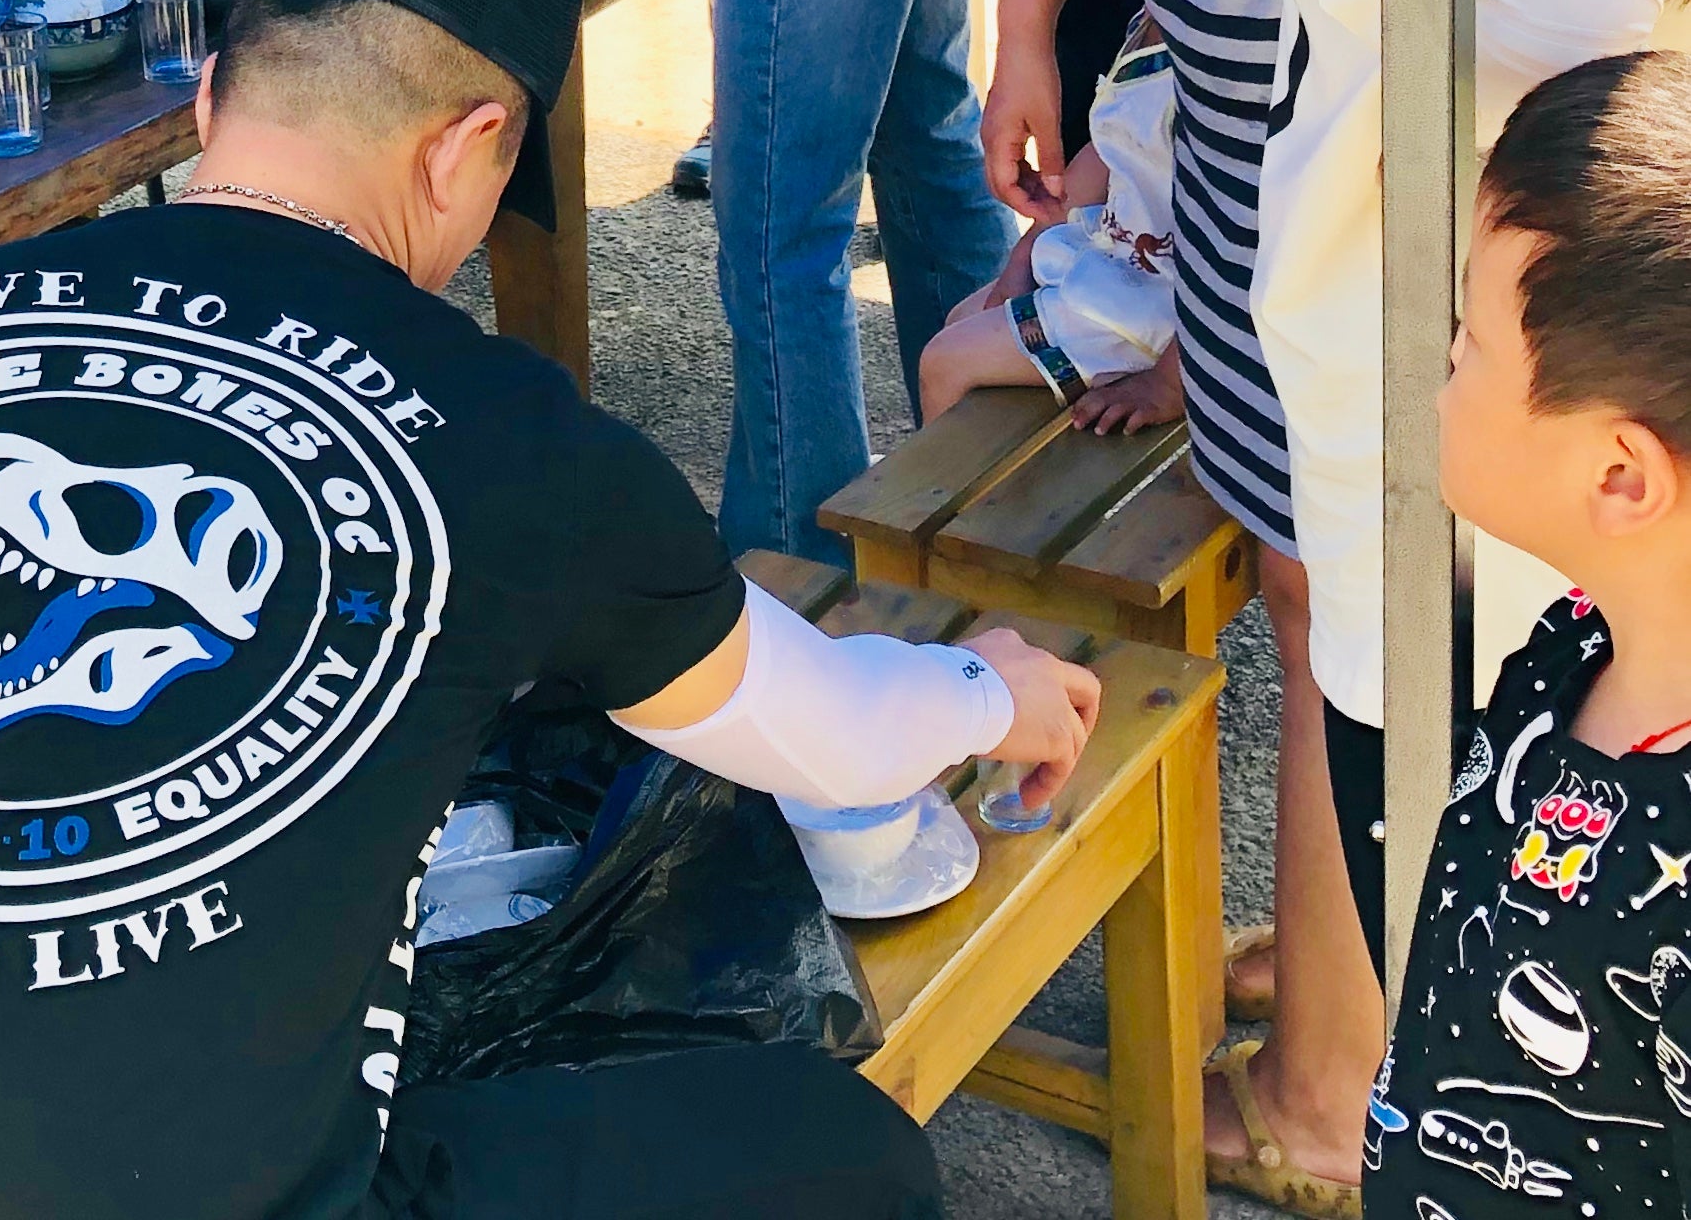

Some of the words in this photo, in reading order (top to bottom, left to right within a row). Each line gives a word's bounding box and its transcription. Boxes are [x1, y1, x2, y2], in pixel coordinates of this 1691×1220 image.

[132, 277, 227, 327] TO
[256, 313, 447, 443] RIDE
[73, 353, 333, 461] BONES
[322, 478, 392, 554] OC
[113, 645, 359, 841] EQUALITY
[28, 880, 244, 991] LIVE
